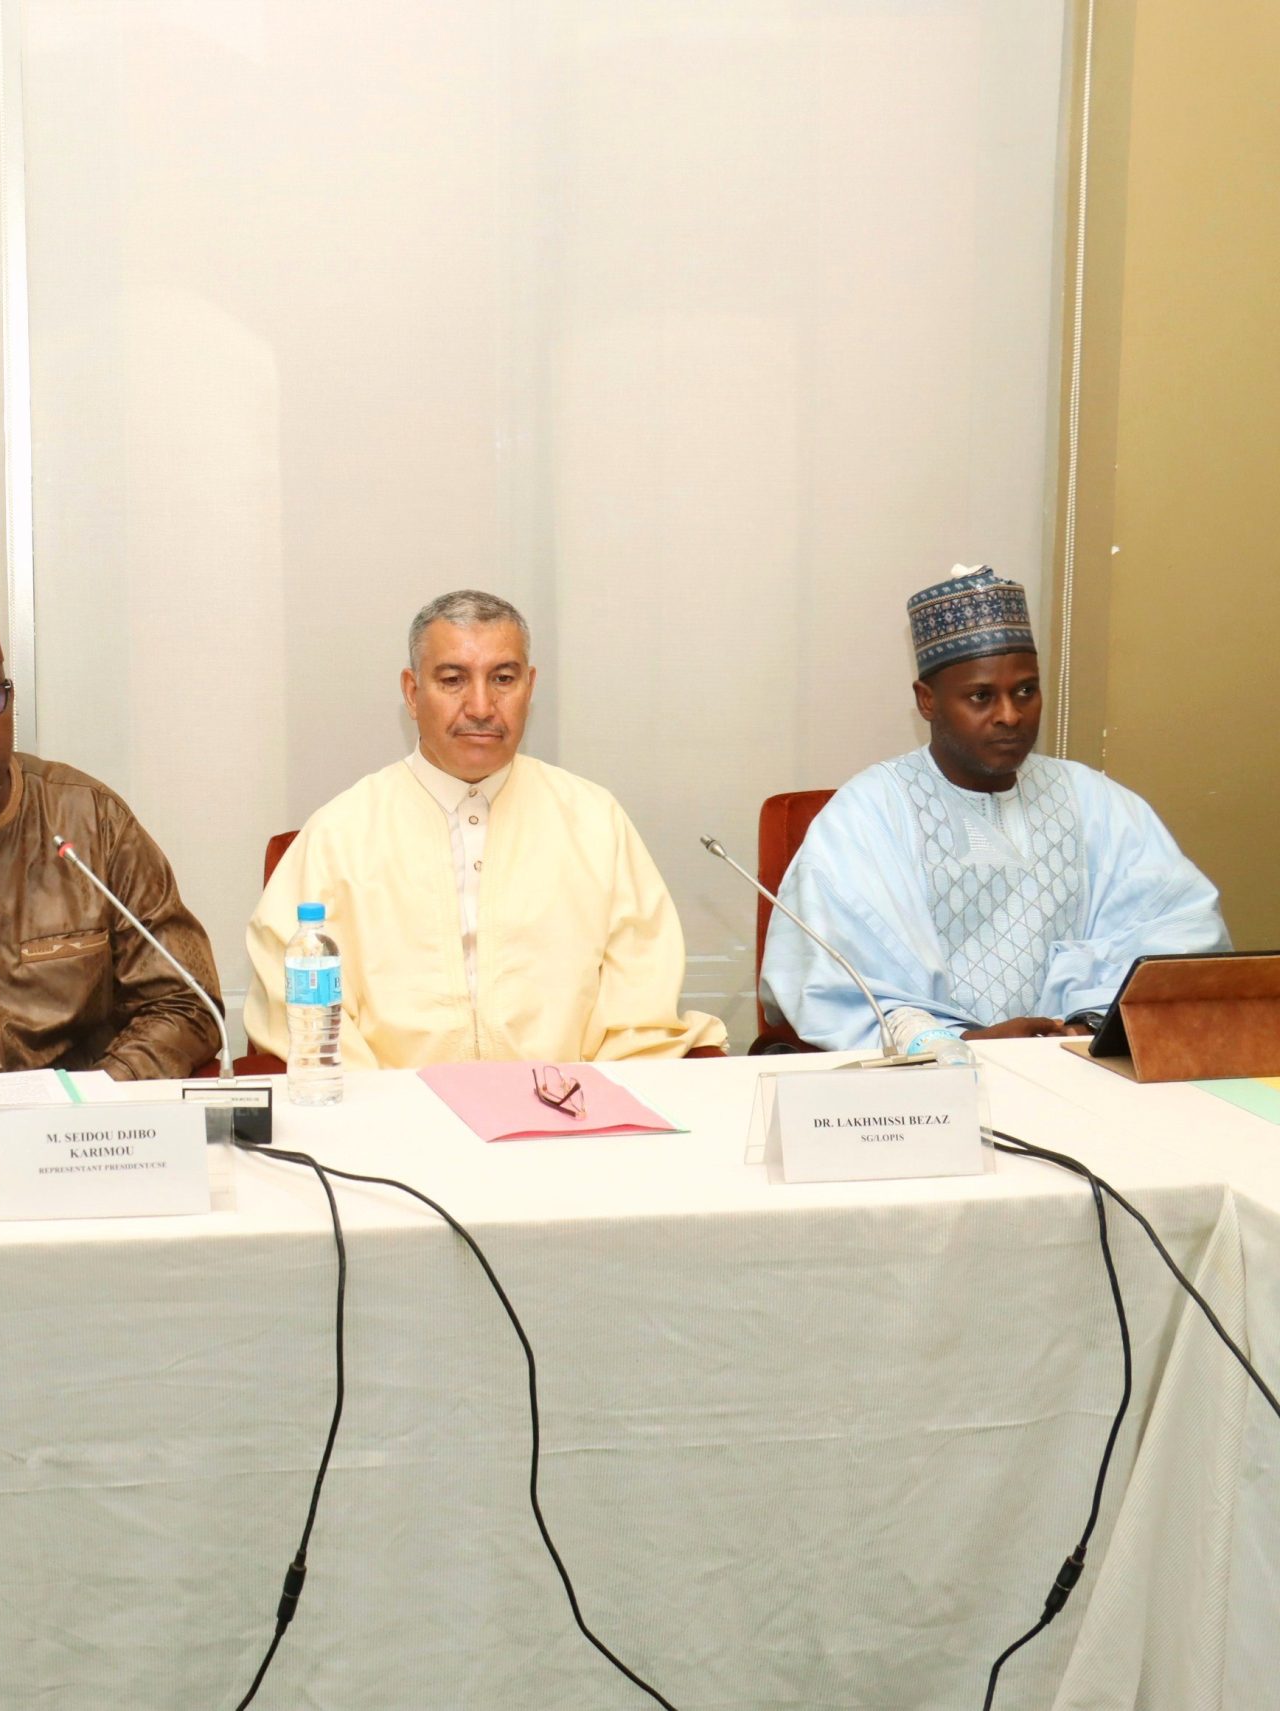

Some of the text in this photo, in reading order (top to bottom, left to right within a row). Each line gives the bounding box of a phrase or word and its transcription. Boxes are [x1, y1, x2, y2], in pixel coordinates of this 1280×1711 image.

[813, 1114, 951, 1128] DR. LAKHMISSI BEZAZ
[46, 1128, 157, 1143] M. SEIDOU DJIBO
[70, 1146, 134, 1159] KARIMOU
[38, 1164, 102, 1175] REPRESENTANT
